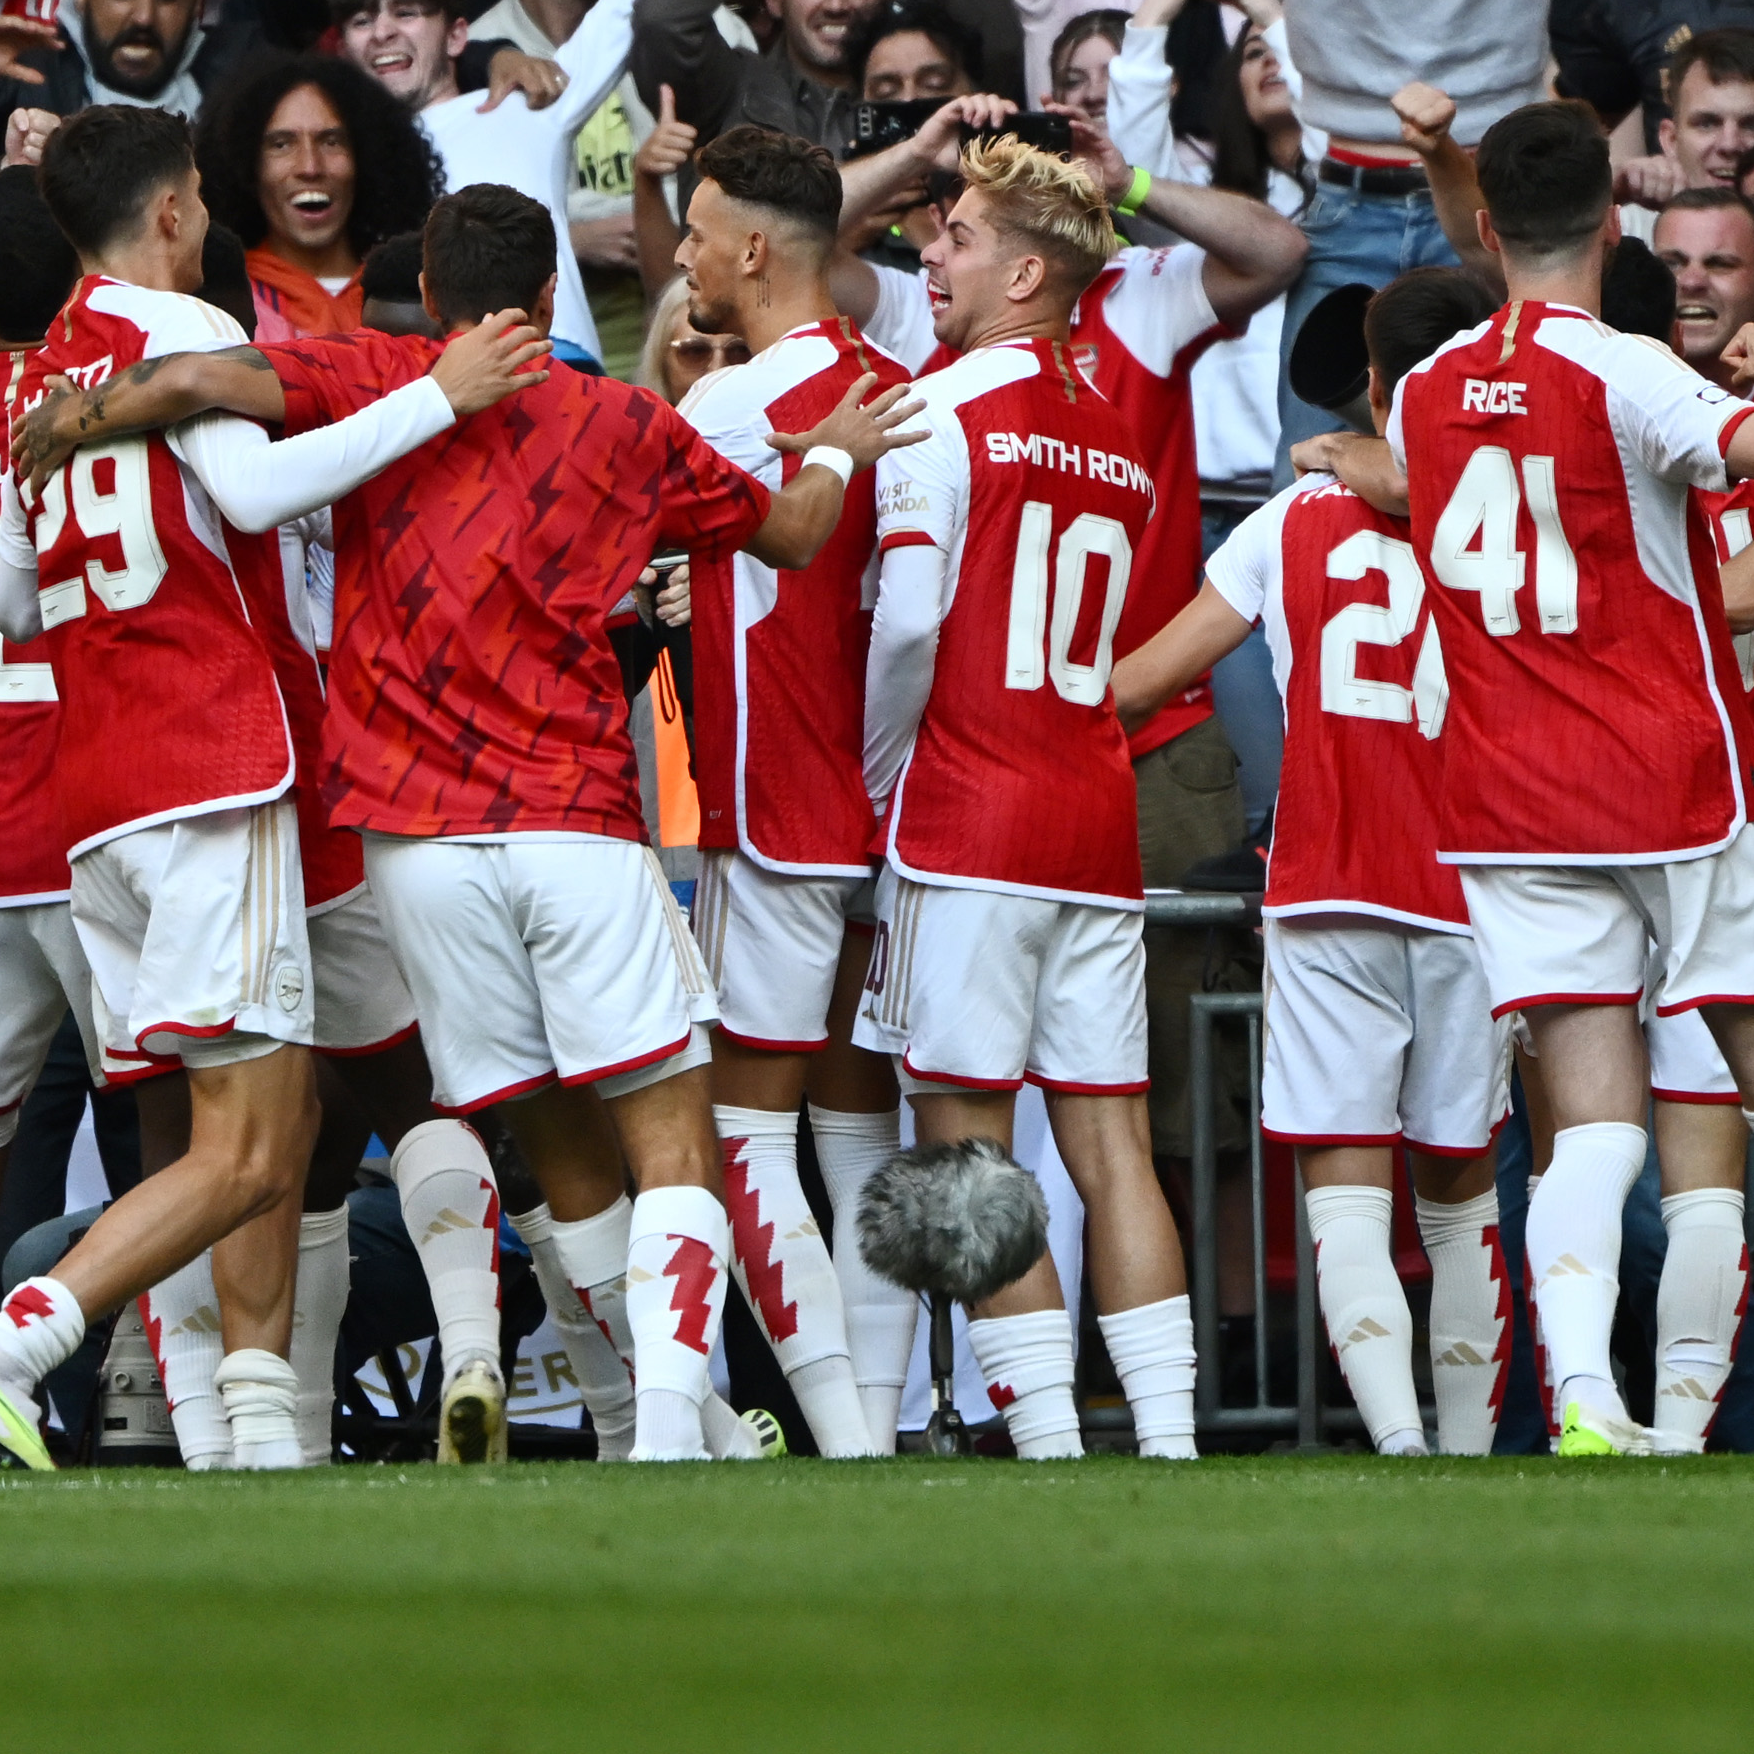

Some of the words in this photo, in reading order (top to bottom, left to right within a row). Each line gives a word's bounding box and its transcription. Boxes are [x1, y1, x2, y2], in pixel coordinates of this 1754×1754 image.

[1463, 379, 1528, 415] RICE
[878, 481, 912, 502] VISIT
[986, 432, 1081, 476] SMITH
[1087, 449, 1155, 508] ROW
[1431, 446, 1578, 635] 41
[1006, 500, 1132, 706] 10
